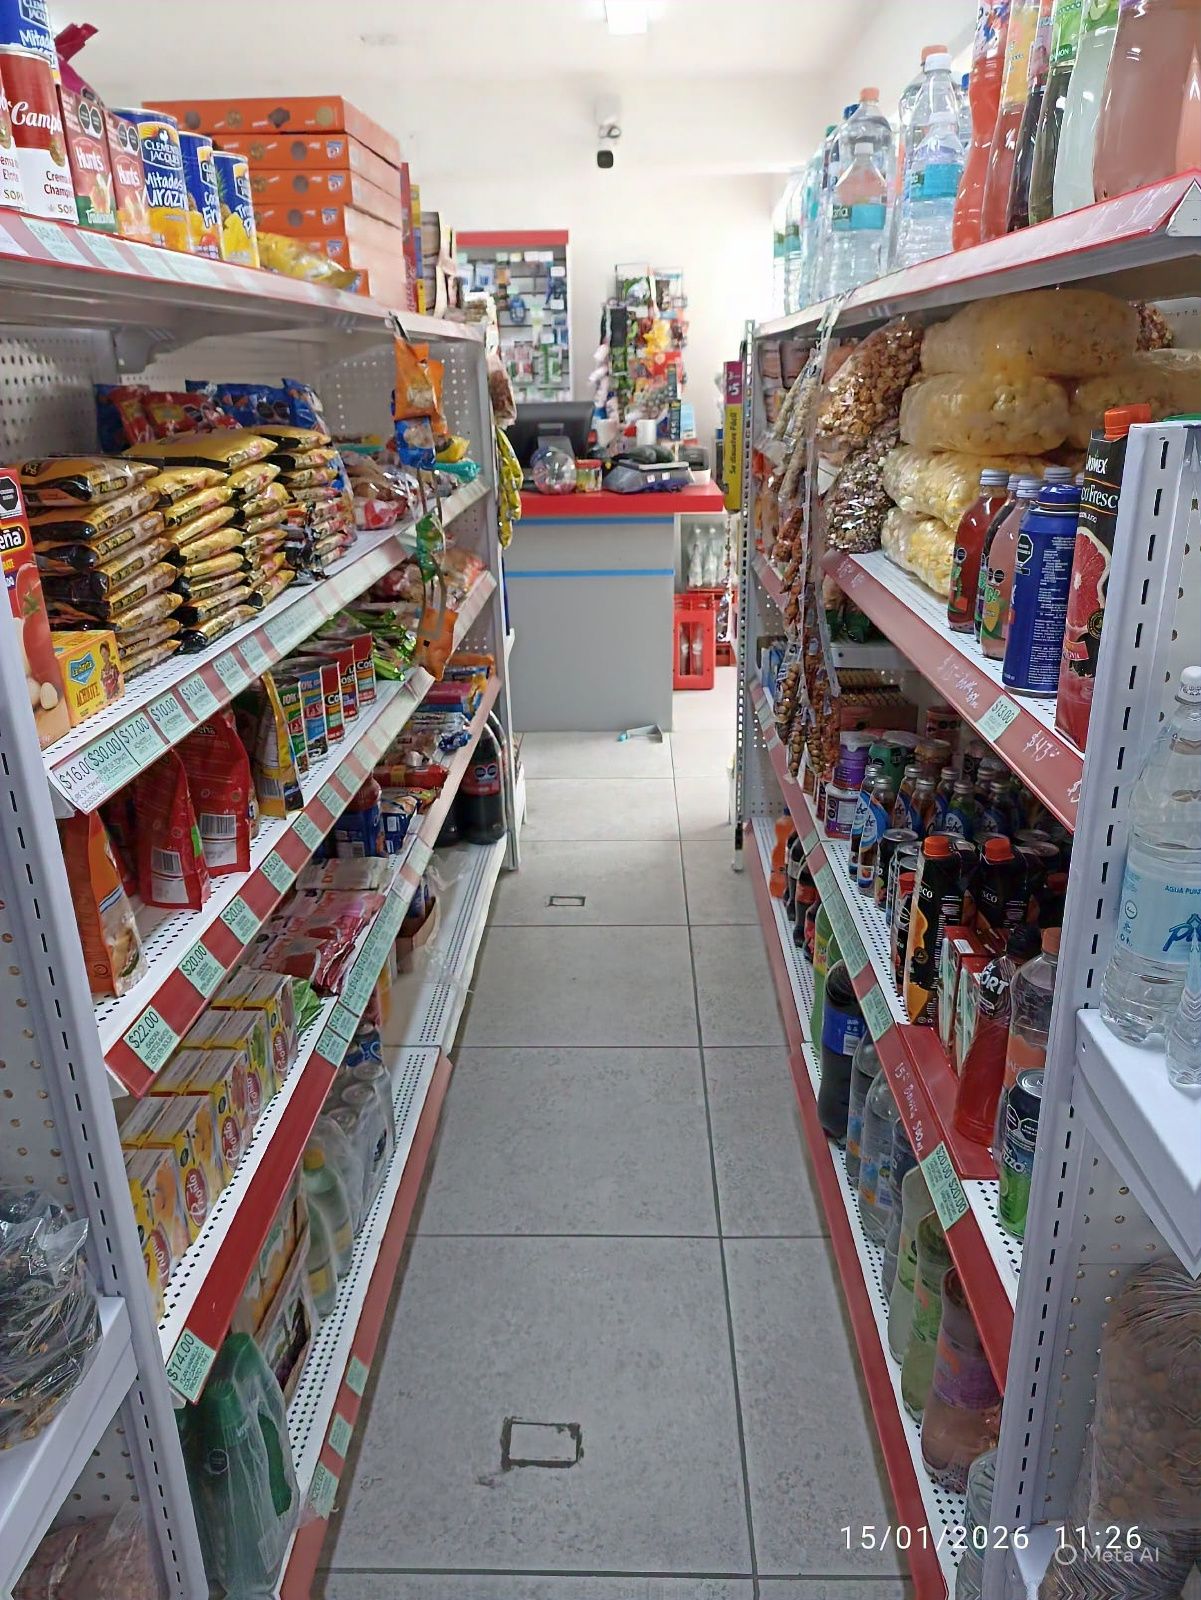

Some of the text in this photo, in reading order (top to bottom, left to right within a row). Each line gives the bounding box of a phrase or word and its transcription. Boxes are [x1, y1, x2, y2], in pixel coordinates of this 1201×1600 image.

[151, 698, 179, 722] $10.00
[119, 717, 150, 743] $17.00
[88, 738, 121, 766] $30.00
[181, 944, 207, 976] $20.00
[128, 1010, 159, 1049] $22.00
[936, 1145, 953, 1179] $20.00
[187, 1174, 207, 1216] Pronto
[948, 1177, 967, 1214] $20.00
[166, 1333, 195, 1381] $14.00
